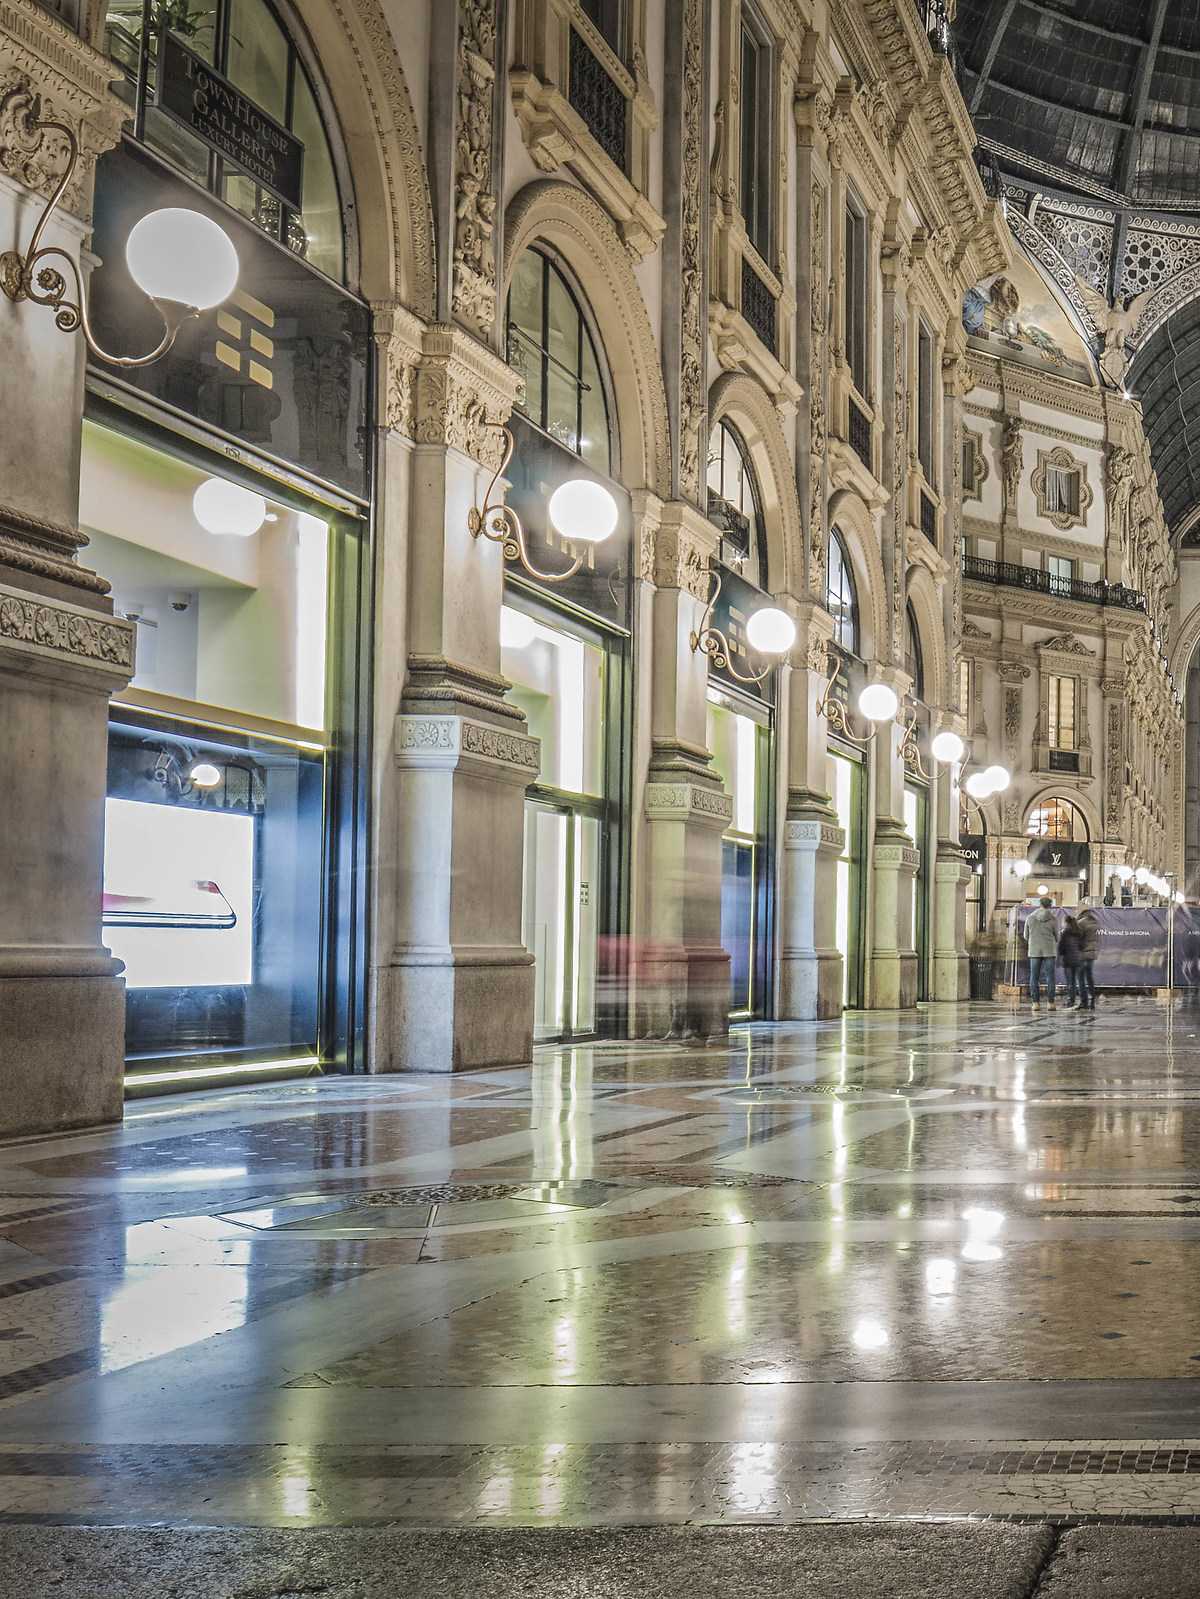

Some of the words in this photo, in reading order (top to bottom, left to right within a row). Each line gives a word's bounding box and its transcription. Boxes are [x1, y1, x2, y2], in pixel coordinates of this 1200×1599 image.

[190, 112, 238, 156] LUXURY
[240, 154, 277, 187] HOTEL
[192, 89, 276, 172] GALLERIA
